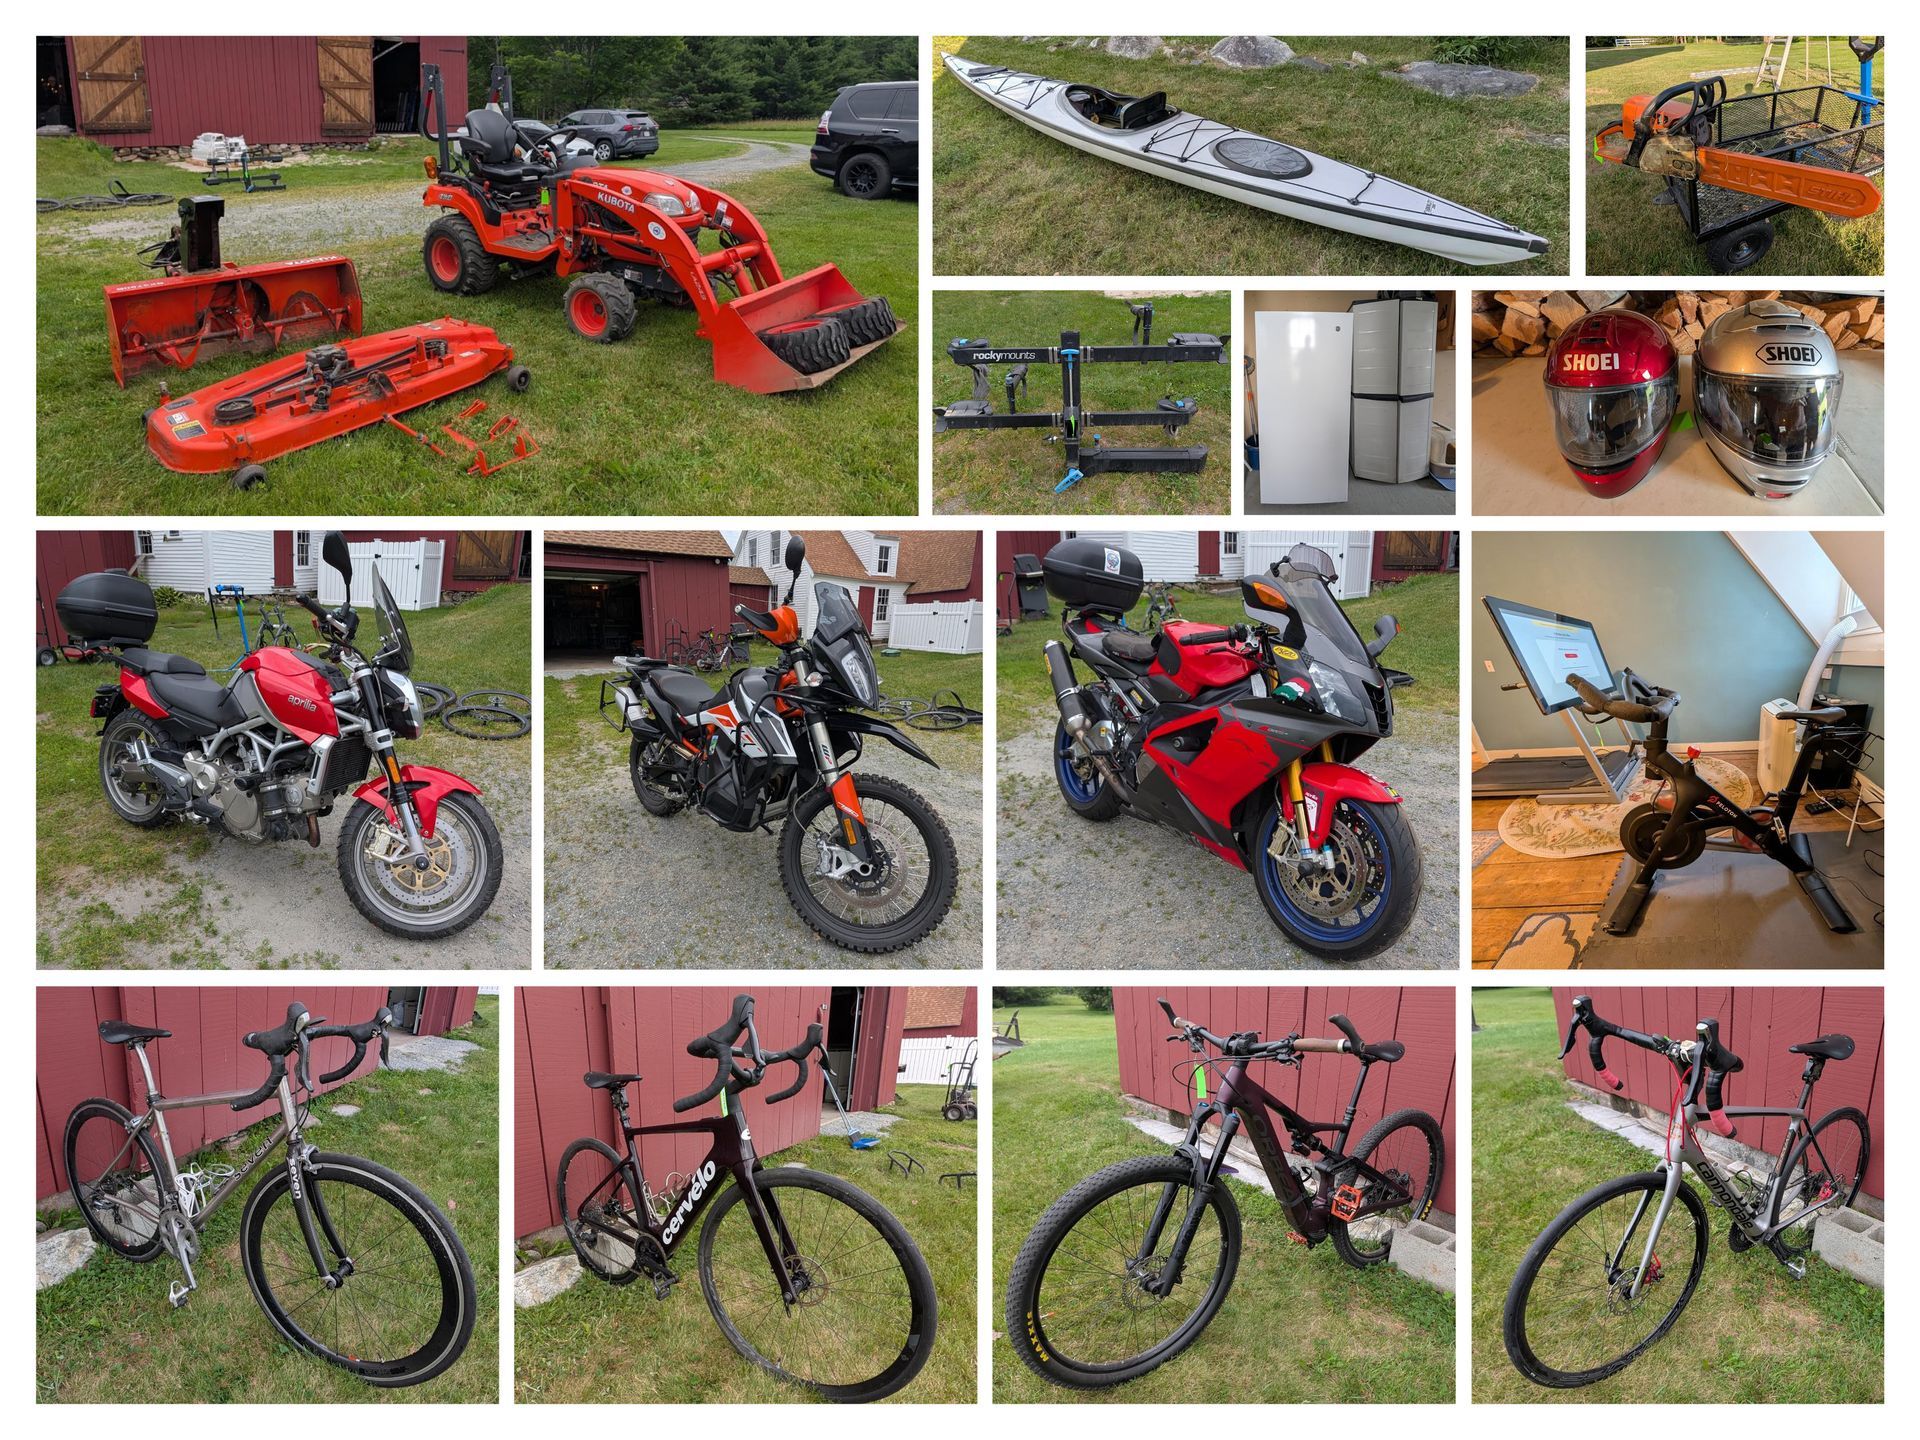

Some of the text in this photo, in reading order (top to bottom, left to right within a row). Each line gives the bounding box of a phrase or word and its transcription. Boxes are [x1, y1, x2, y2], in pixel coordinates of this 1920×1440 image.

[597, 191, 635, 213] KUBOTA
[1807, 186, 1857, 204] STIHL
[973, 350, 1036, 362] rockymounts
[1563, 352, 1620, 371] SHOEI
[1765, 346, 1816, 363] SHOEI
[288, 694, 317, 712] aprilia
[1716, 801, 1738, 819] PELOTON
[234, 1135, 273, 1181] seven
[290, 1158, 302, 1199] seven
[662, 1160, 716, 1245] cervélo
[1696, 1161, 1754, 1230] cannondale
[1026, 1311, 1049, 1362] MAXXIS
